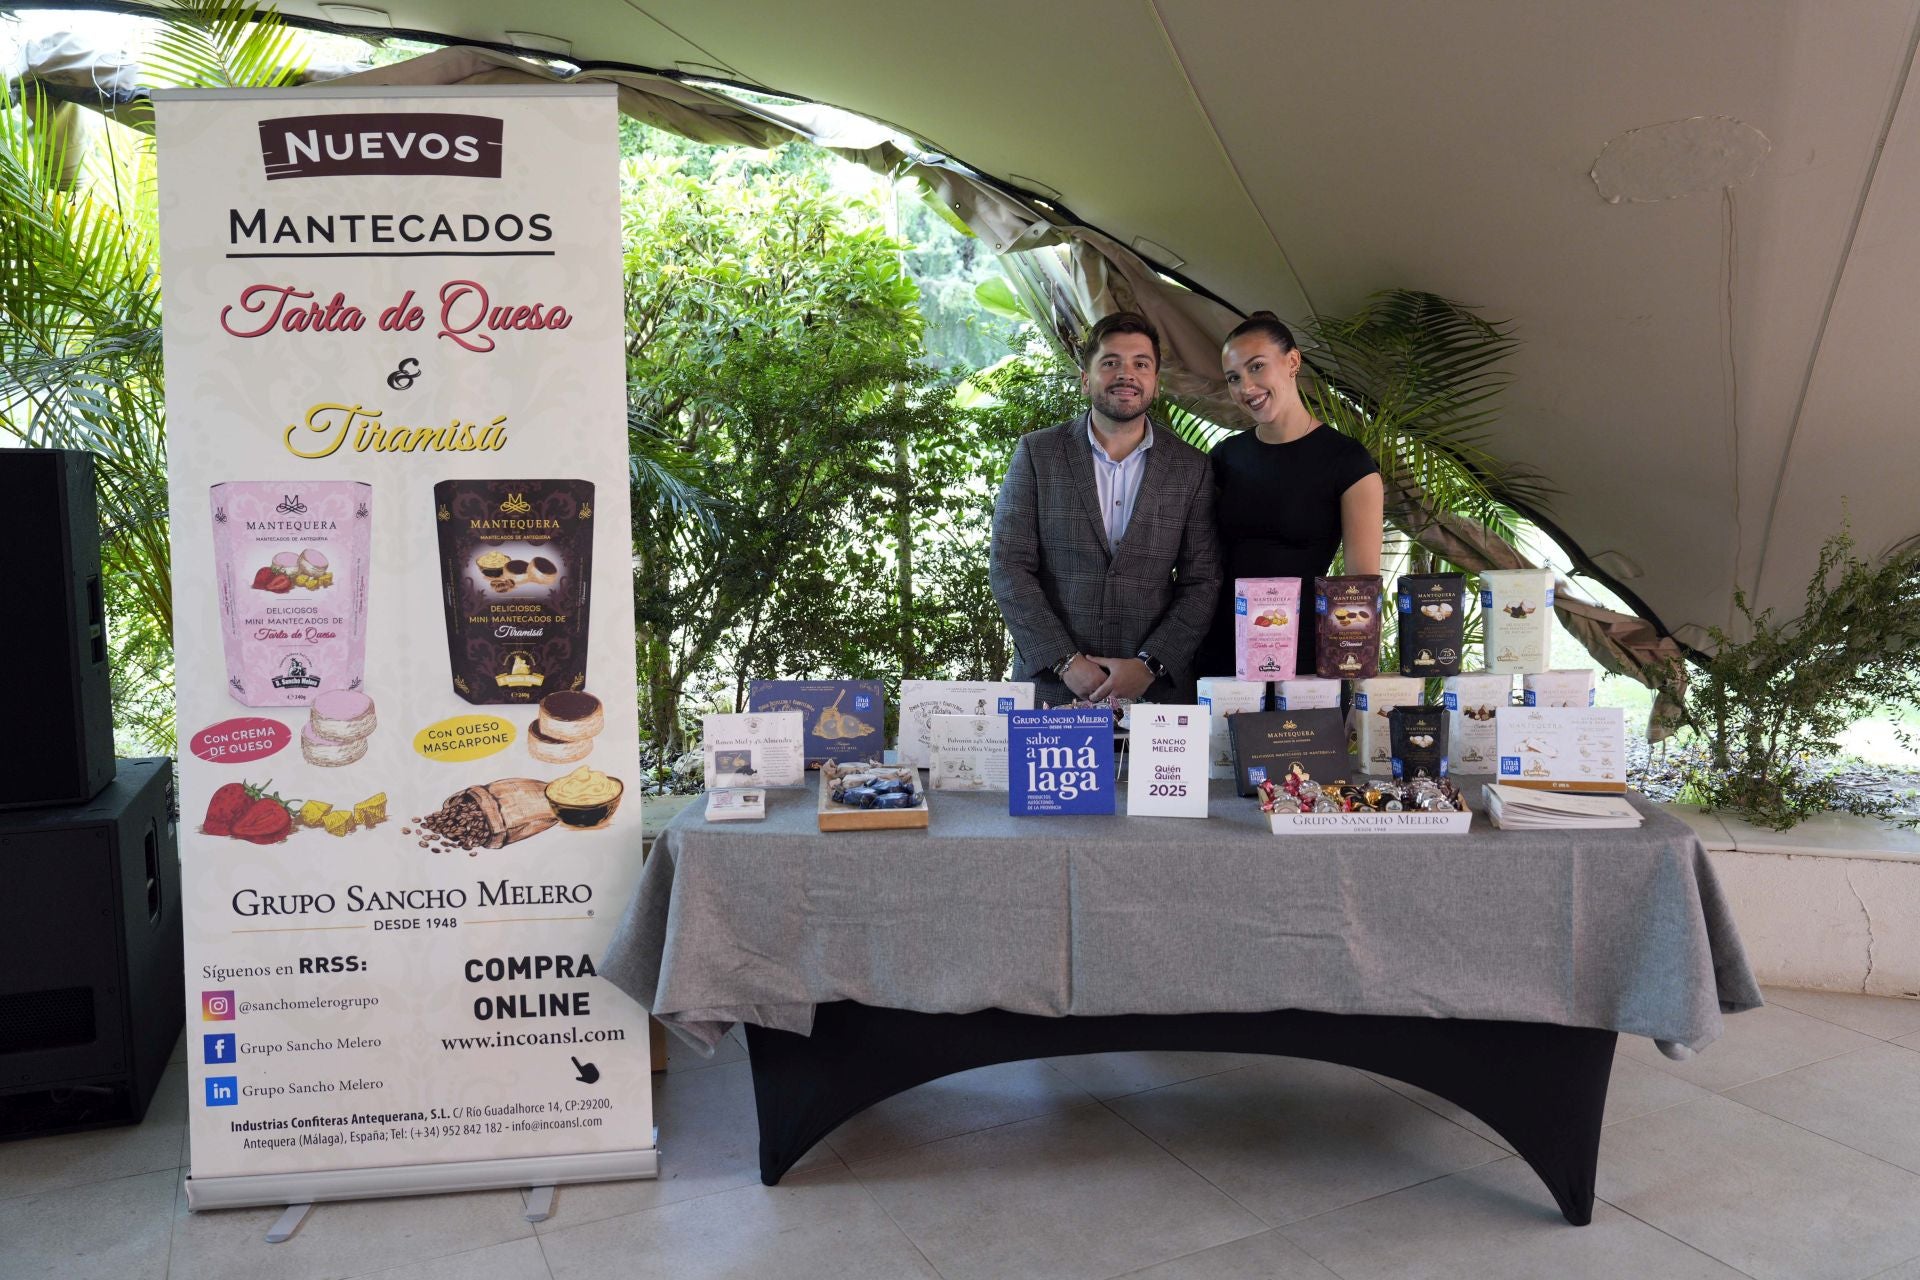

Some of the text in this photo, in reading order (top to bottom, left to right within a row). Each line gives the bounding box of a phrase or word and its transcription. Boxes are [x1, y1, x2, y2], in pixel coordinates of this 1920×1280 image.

[221, 280, 572, 352] Tarta de Queso
[387, 358, 421, 390] &
[284, 403, 508, 459] Tiramisú
[246, 521, 337, 531] MANTEQUERA
[470, 519, 560, 530] MANTEQUERA
[266, 606, 318, 614] DELICIOSOS
[490, 605, 541, 613] DELICIOSOS
[267, 617, 329, 625] MANTECADOS
[332, 617, 343, 625] DE
[492, 615, 551, 623] MANTECADOS
[555, 615, 566, 623] DE
[254, 627, 336, 643] Tarta de Queso
[494, 625, 543, 638] Tiramisú
[1013, 715, 1108, 724] GRUPO SANCHO MELERO
[231, 727, 276, 741] CREMA
[456, 721, 499, 736] QUESO
[1267, 731, 1315, 739] MANTEQUERA
[423, 733, 509, 753] MASCARPONE
[1026, 733, 1061, 744] sabor
[210, 739, 273, 757] DE QUESO
[1026, 736, 1099, 768] a má
[1026, 762, 1099, 800] laga
[1155, 772, 1181, 780] Quién
[1149, 784, 1187, 797] 2025
[1292, 813, 1449, 826] GRUPO SANCHO MELERO
[373, 917, 457, 931] DESDE 1948
[202, 955, 367, 982] Síguenos en RRSS:
[464, 954, 598, 983] COMPRA
[239, 996, 379, 1015] @sanchomelerogrupo
[473, 991, 590, 1021] ONLINE
[240, 1036, 382, 1057] Grupo Sancho Melero
[441, 1027, 625, 1050] www.incoansl.com
[242, 1078, 384, 1099] Grupo Sancho Melero
[231, 1098, 613, 1133] Industrias Confiteras Antequerana, S.L. C/ Río Guadalhorce 14, CP:29200,
[243, 1137, 296, 1150] Antequera
[299, 1132, 347, 1147] (Málaga),
[350, 1129, 389, 1144] España;
[391, 1127, 408, 1140] Tel:
[410, 1125, 440, 1140] (+34)
[442, 1125, 461, 1138] 952
[463, 1123, 481, 1136] 842
[485, 1122, 502, 1135] 182
[512, 1117, 603, 1133] info@incoansl.com
